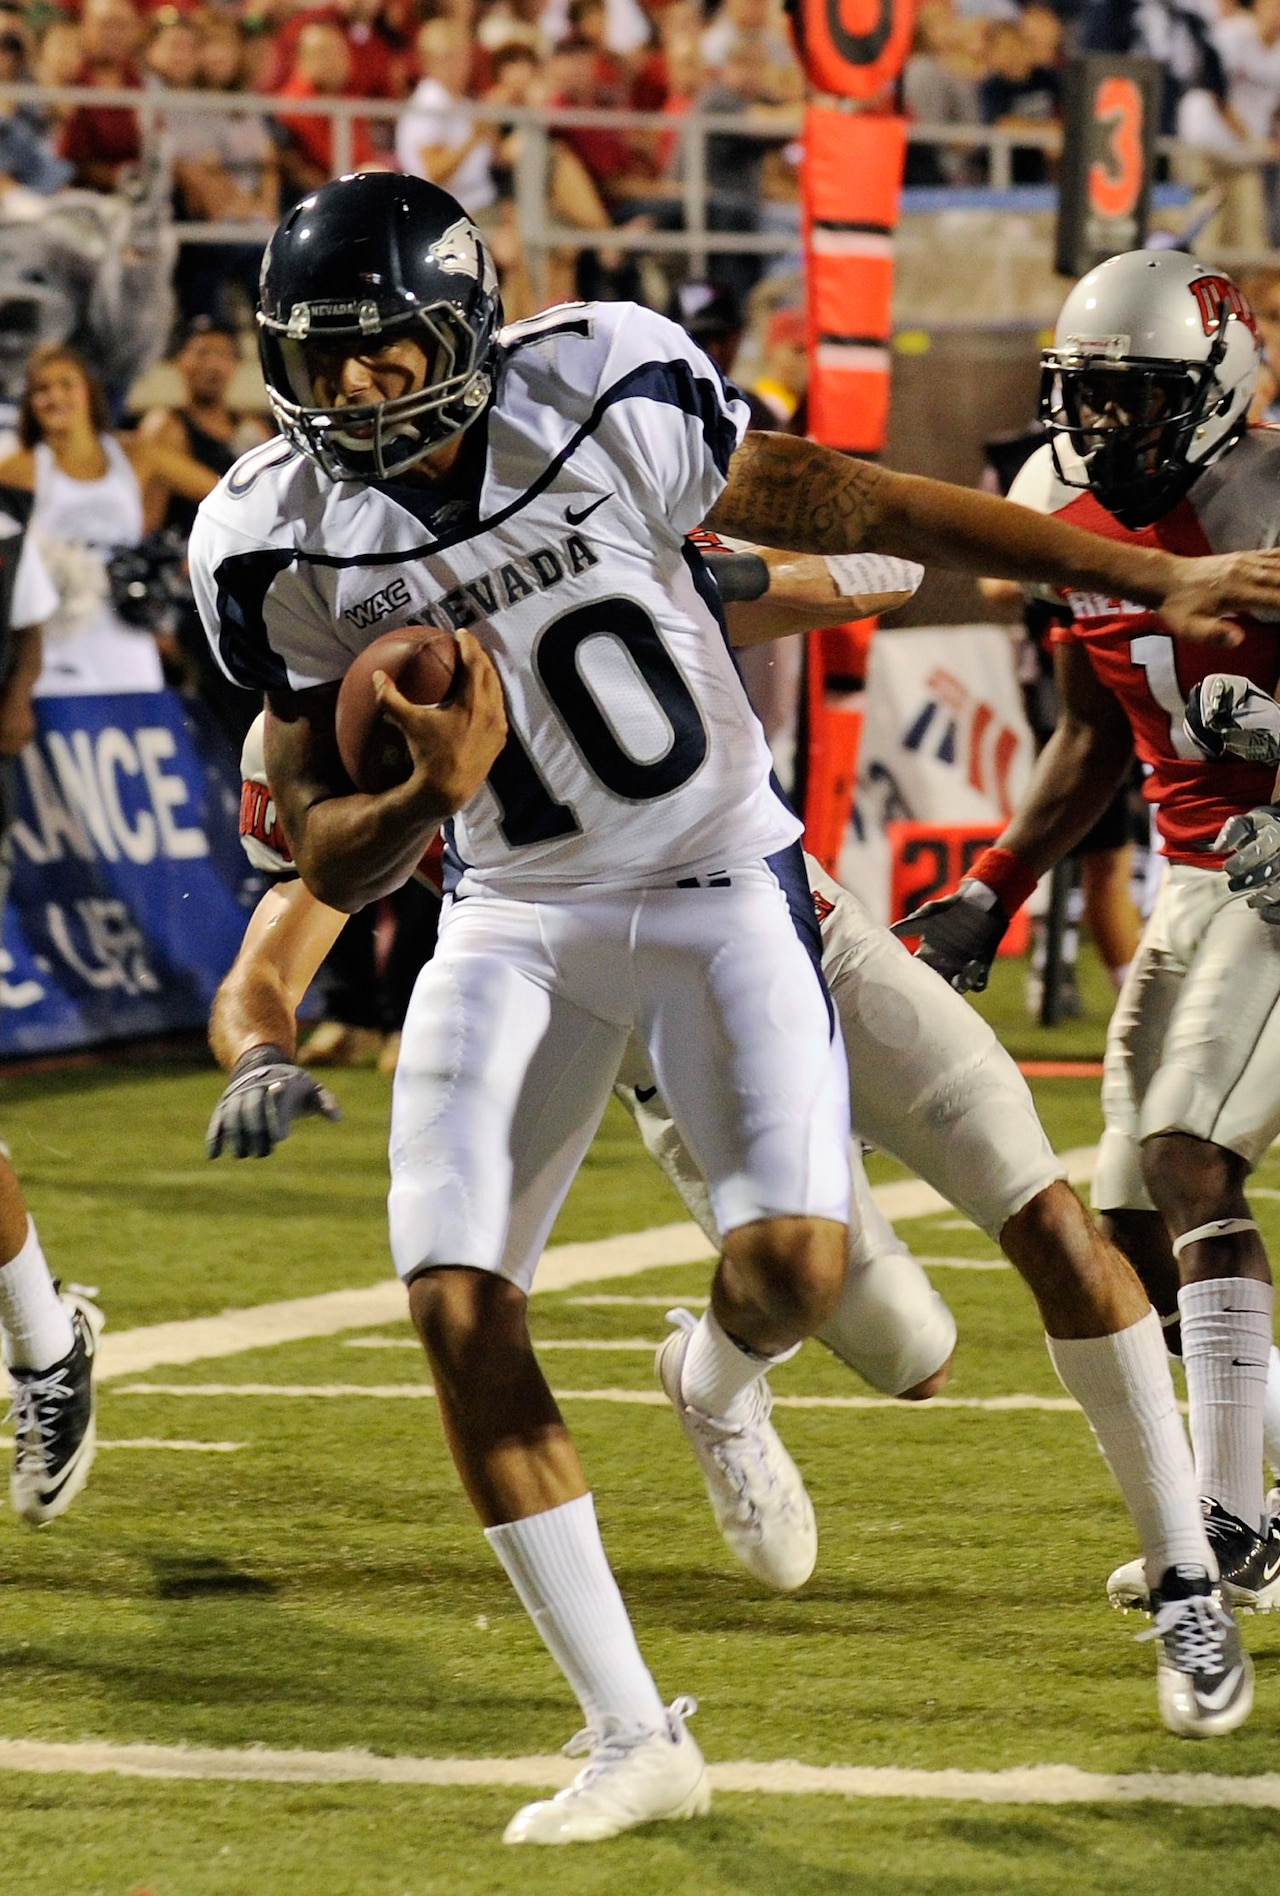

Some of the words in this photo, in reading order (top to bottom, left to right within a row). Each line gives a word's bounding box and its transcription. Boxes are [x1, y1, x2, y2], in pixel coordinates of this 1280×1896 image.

[1087, 77, 1143, 216] 3
[345, 577, 412, 630] WAC
[1128, 633, 1208, 762] 1
